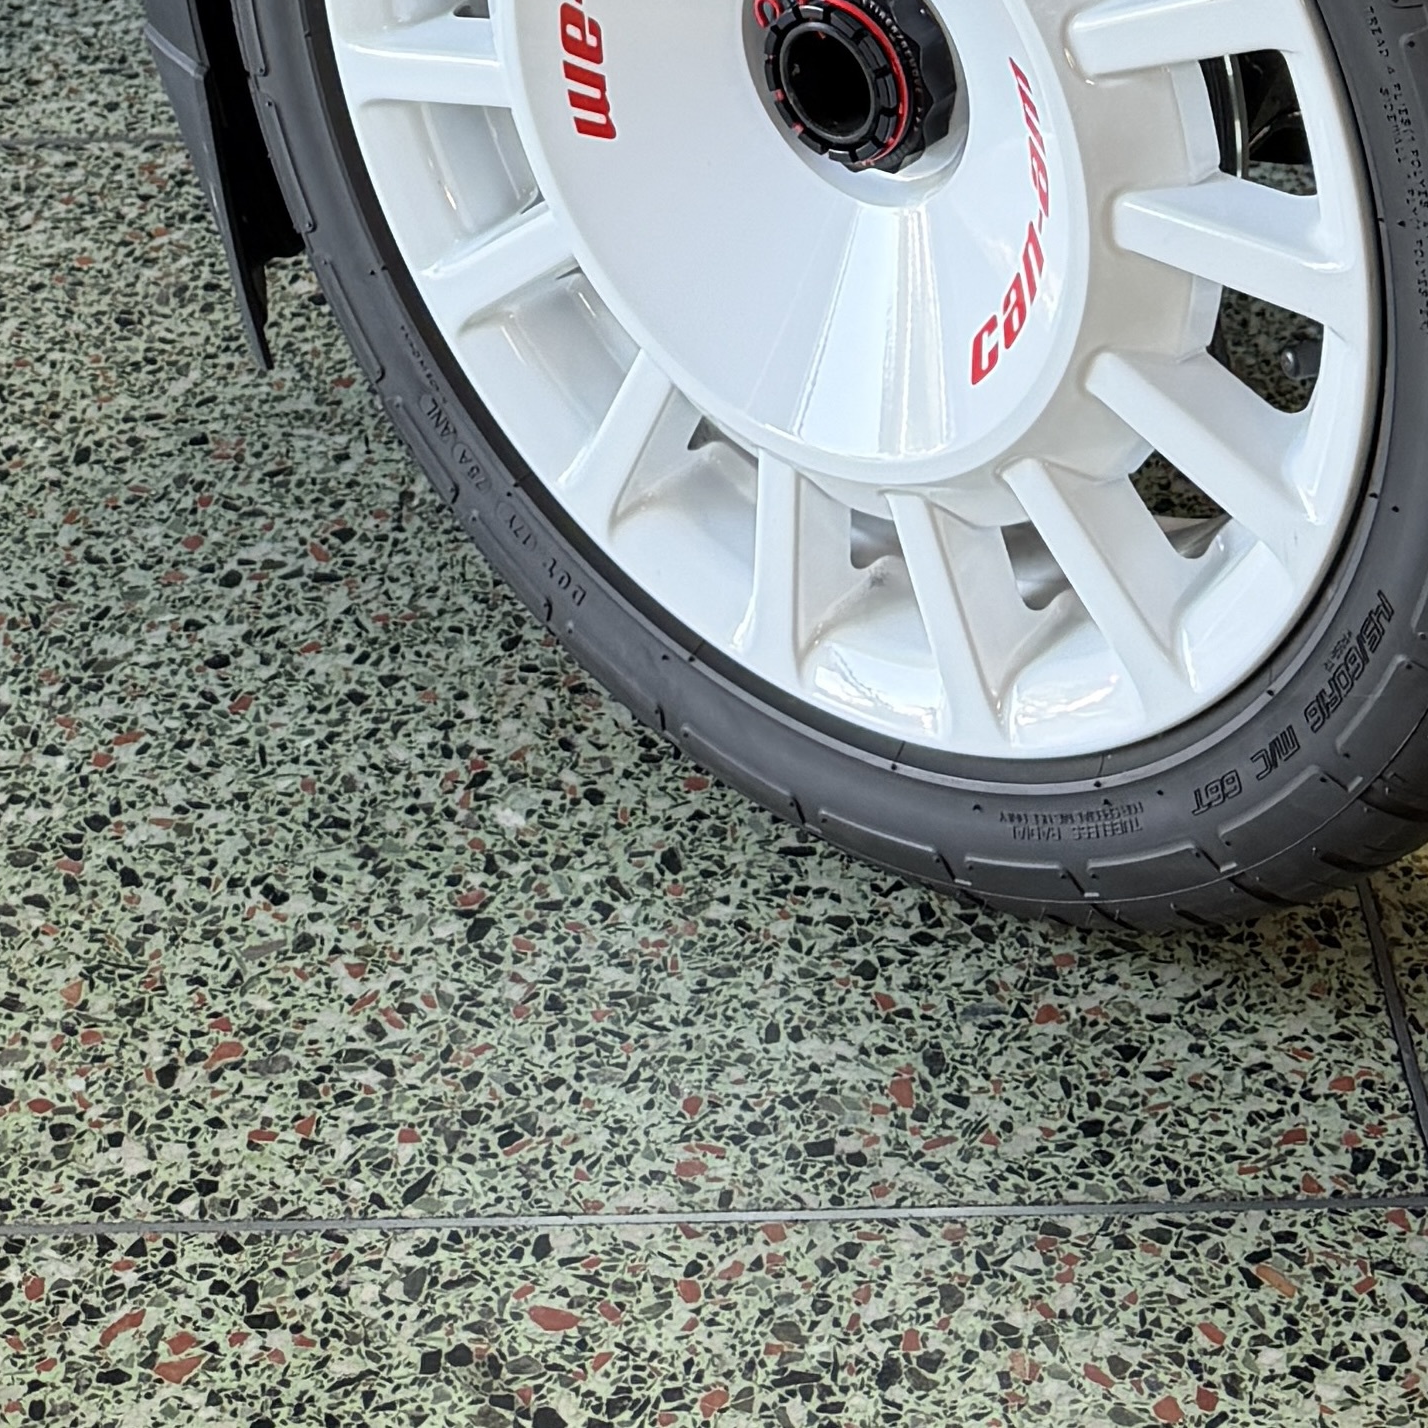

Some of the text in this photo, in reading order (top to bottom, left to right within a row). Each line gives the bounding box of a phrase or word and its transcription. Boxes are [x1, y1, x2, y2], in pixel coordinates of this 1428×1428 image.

[970, 56, 1049, 386] can-am
[1304, 590, 1395, 733] 145/60R16
[1192, 769, 1243, 816] 66T
